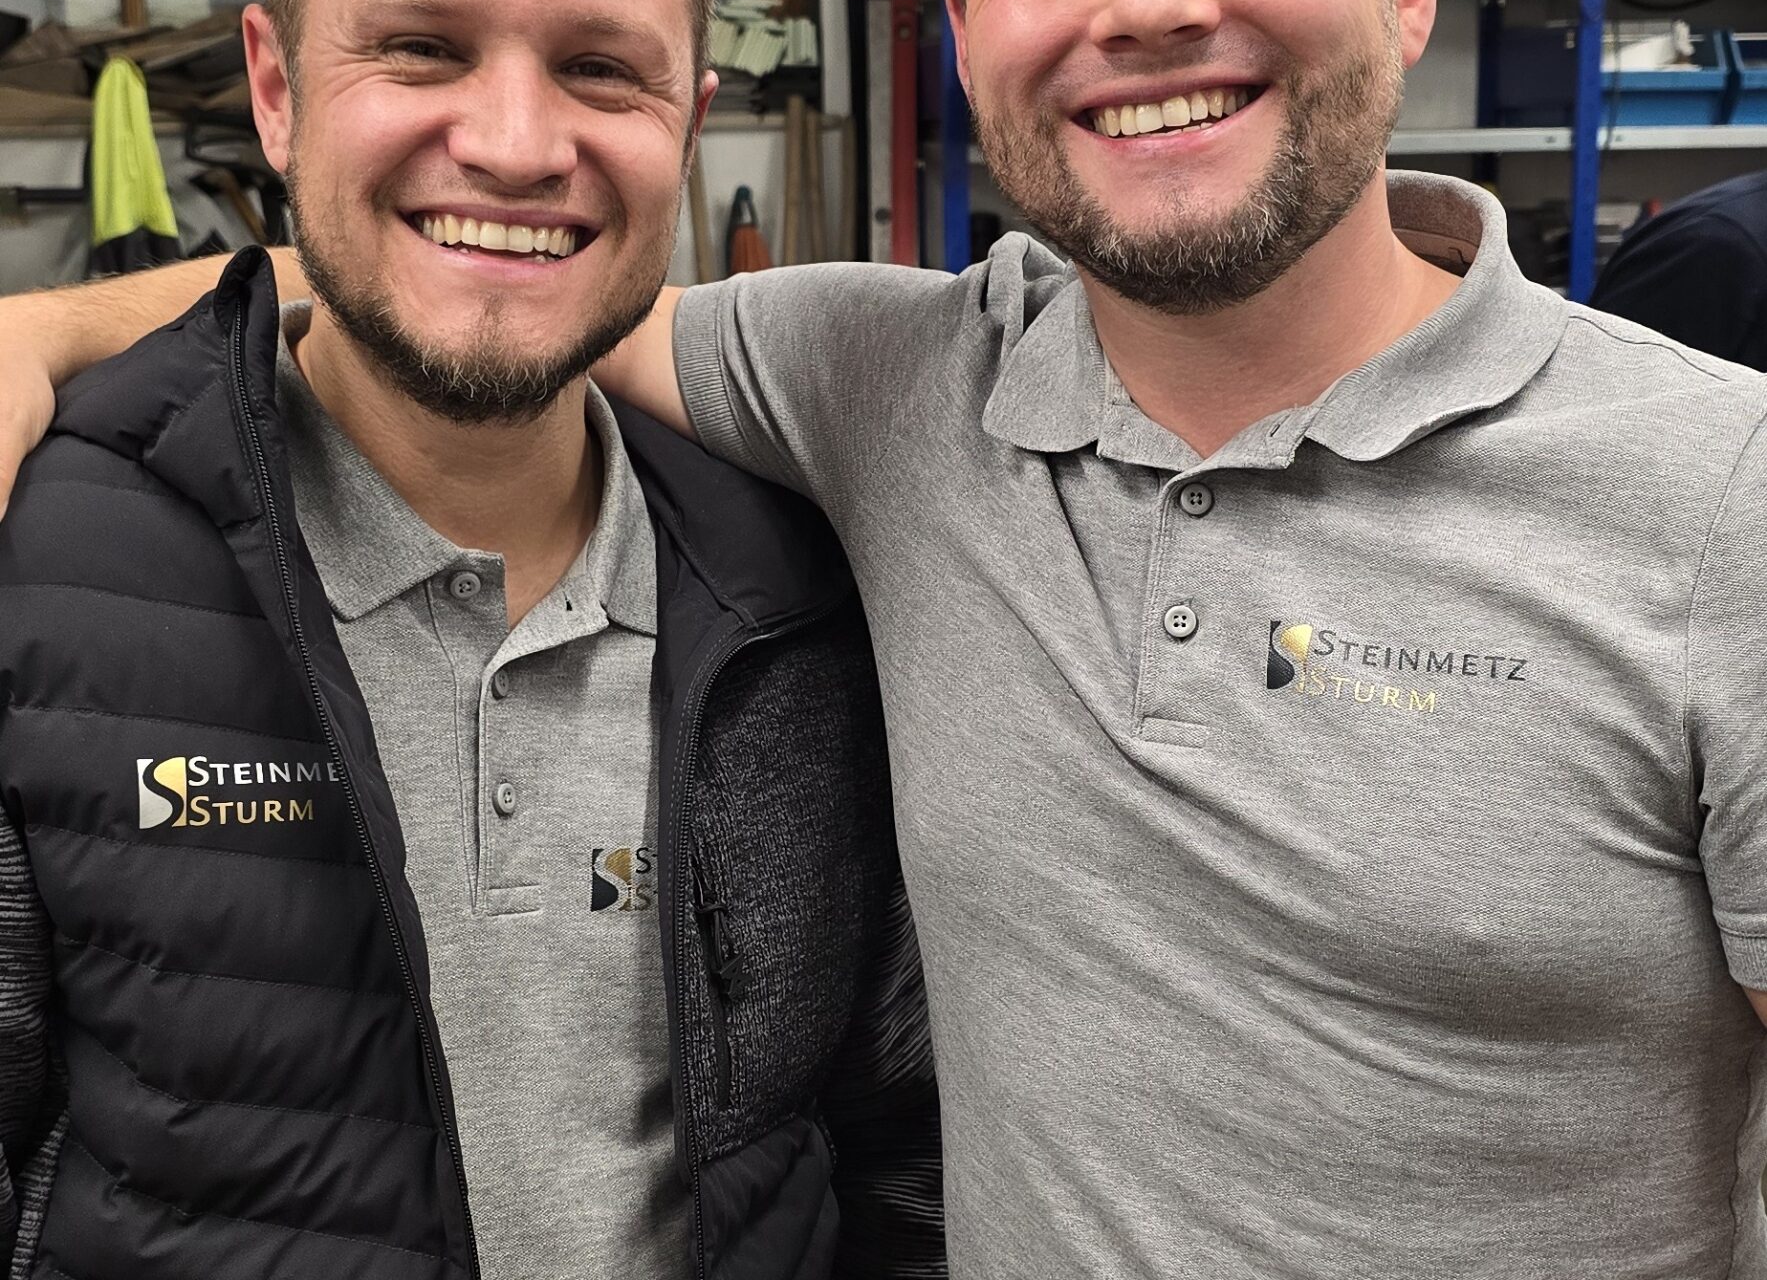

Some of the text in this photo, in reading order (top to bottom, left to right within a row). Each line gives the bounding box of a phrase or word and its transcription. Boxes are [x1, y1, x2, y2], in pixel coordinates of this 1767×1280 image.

[1314, 629, 1527, 681] STEINMETZ
[1306, 665, 1436, 713] STURM
[188, 755, 341, 787] STEINME
[189, 795, 315, 827] STURM
